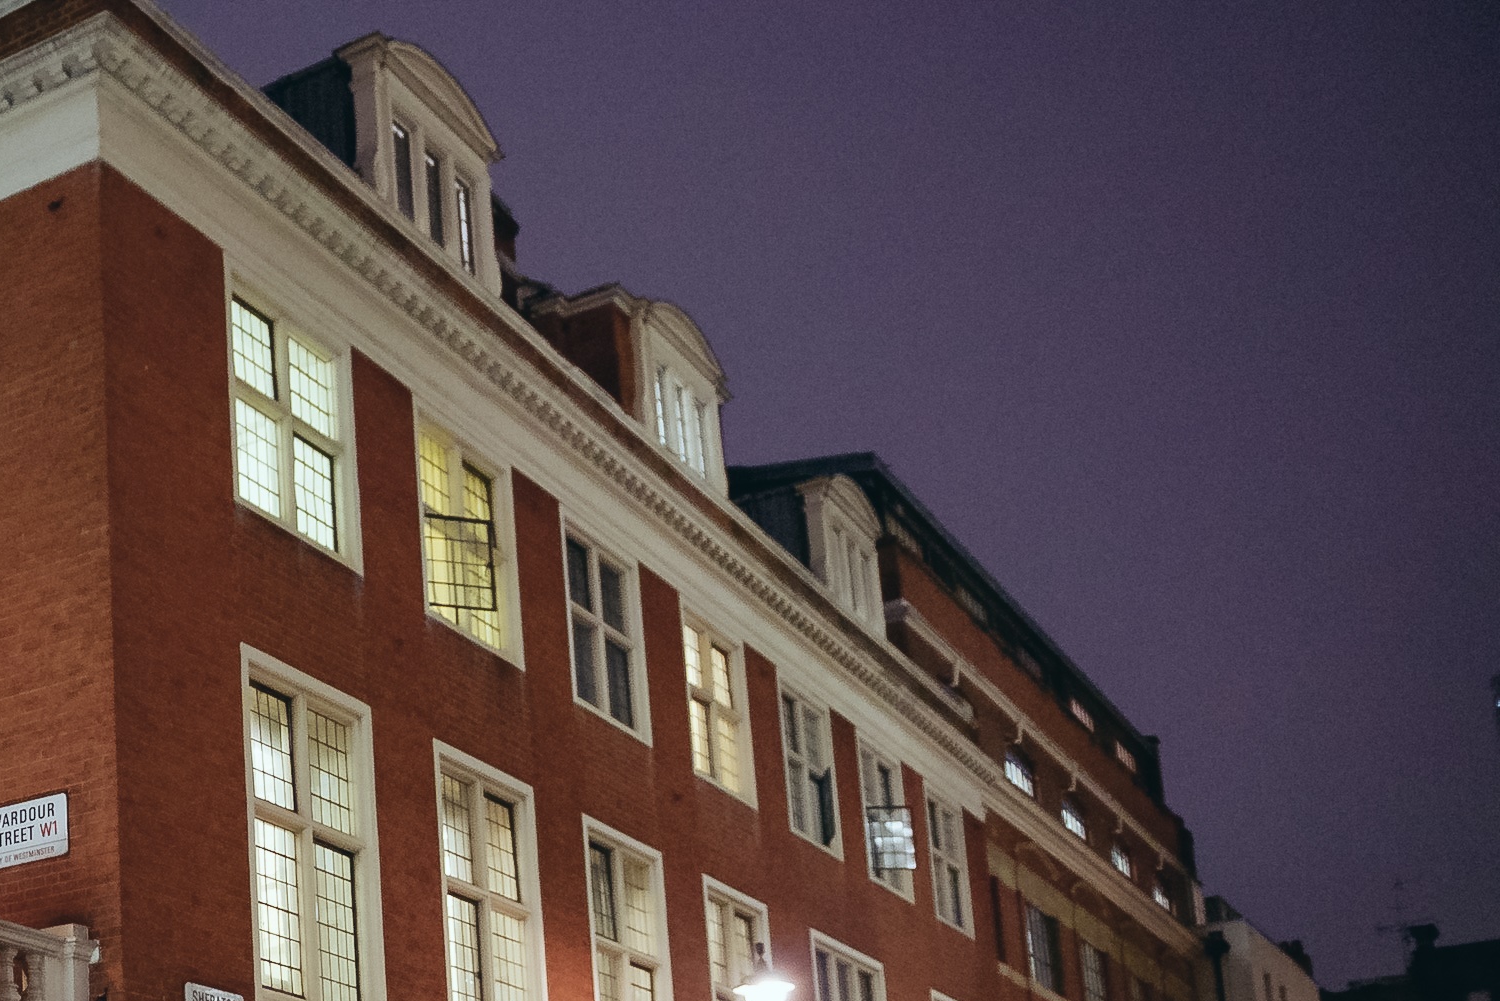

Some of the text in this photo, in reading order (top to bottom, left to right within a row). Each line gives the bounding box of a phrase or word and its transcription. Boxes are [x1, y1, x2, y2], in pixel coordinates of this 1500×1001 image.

[40, 820, 58, 838] W1
[4, 855, 13, 863] OF
[13, 846, 55, 860] WESTMINSTER
